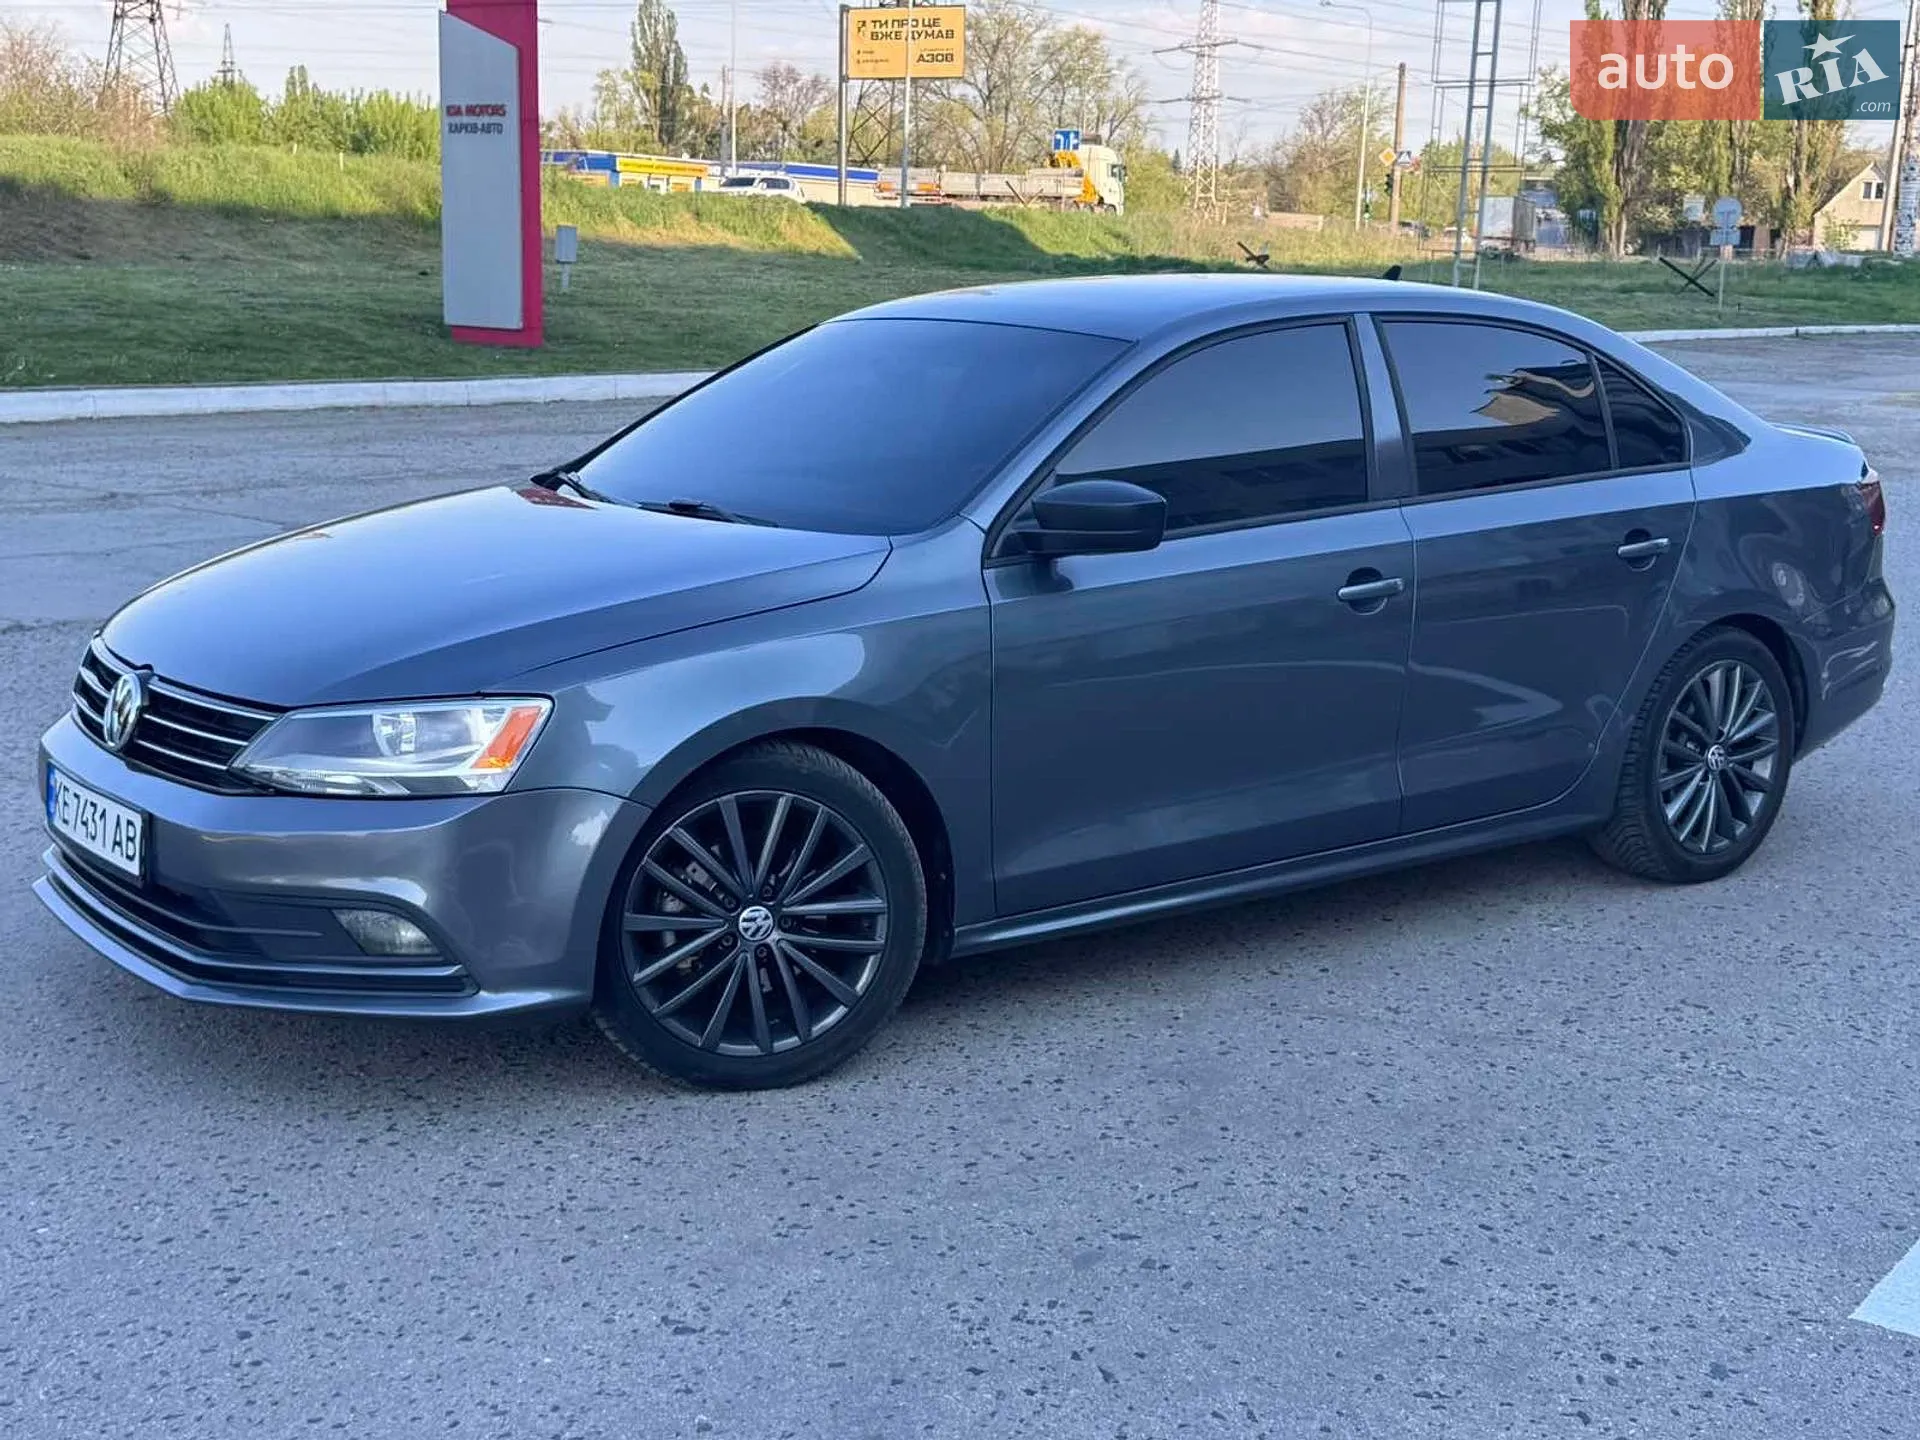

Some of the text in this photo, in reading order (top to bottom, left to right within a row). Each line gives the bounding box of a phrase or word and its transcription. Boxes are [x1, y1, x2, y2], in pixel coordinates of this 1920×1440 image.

[871, 18, 941, 29] ТИ ПРО ЦЕ
[871, 31, 902, 40] ВЖЕ
[916, 53, 955, 63] АЗОВ
[465, 104, 506, 116] MOTORS
[73, 791, 107, 849] 7431
[111, 813, 137, 862] AB
